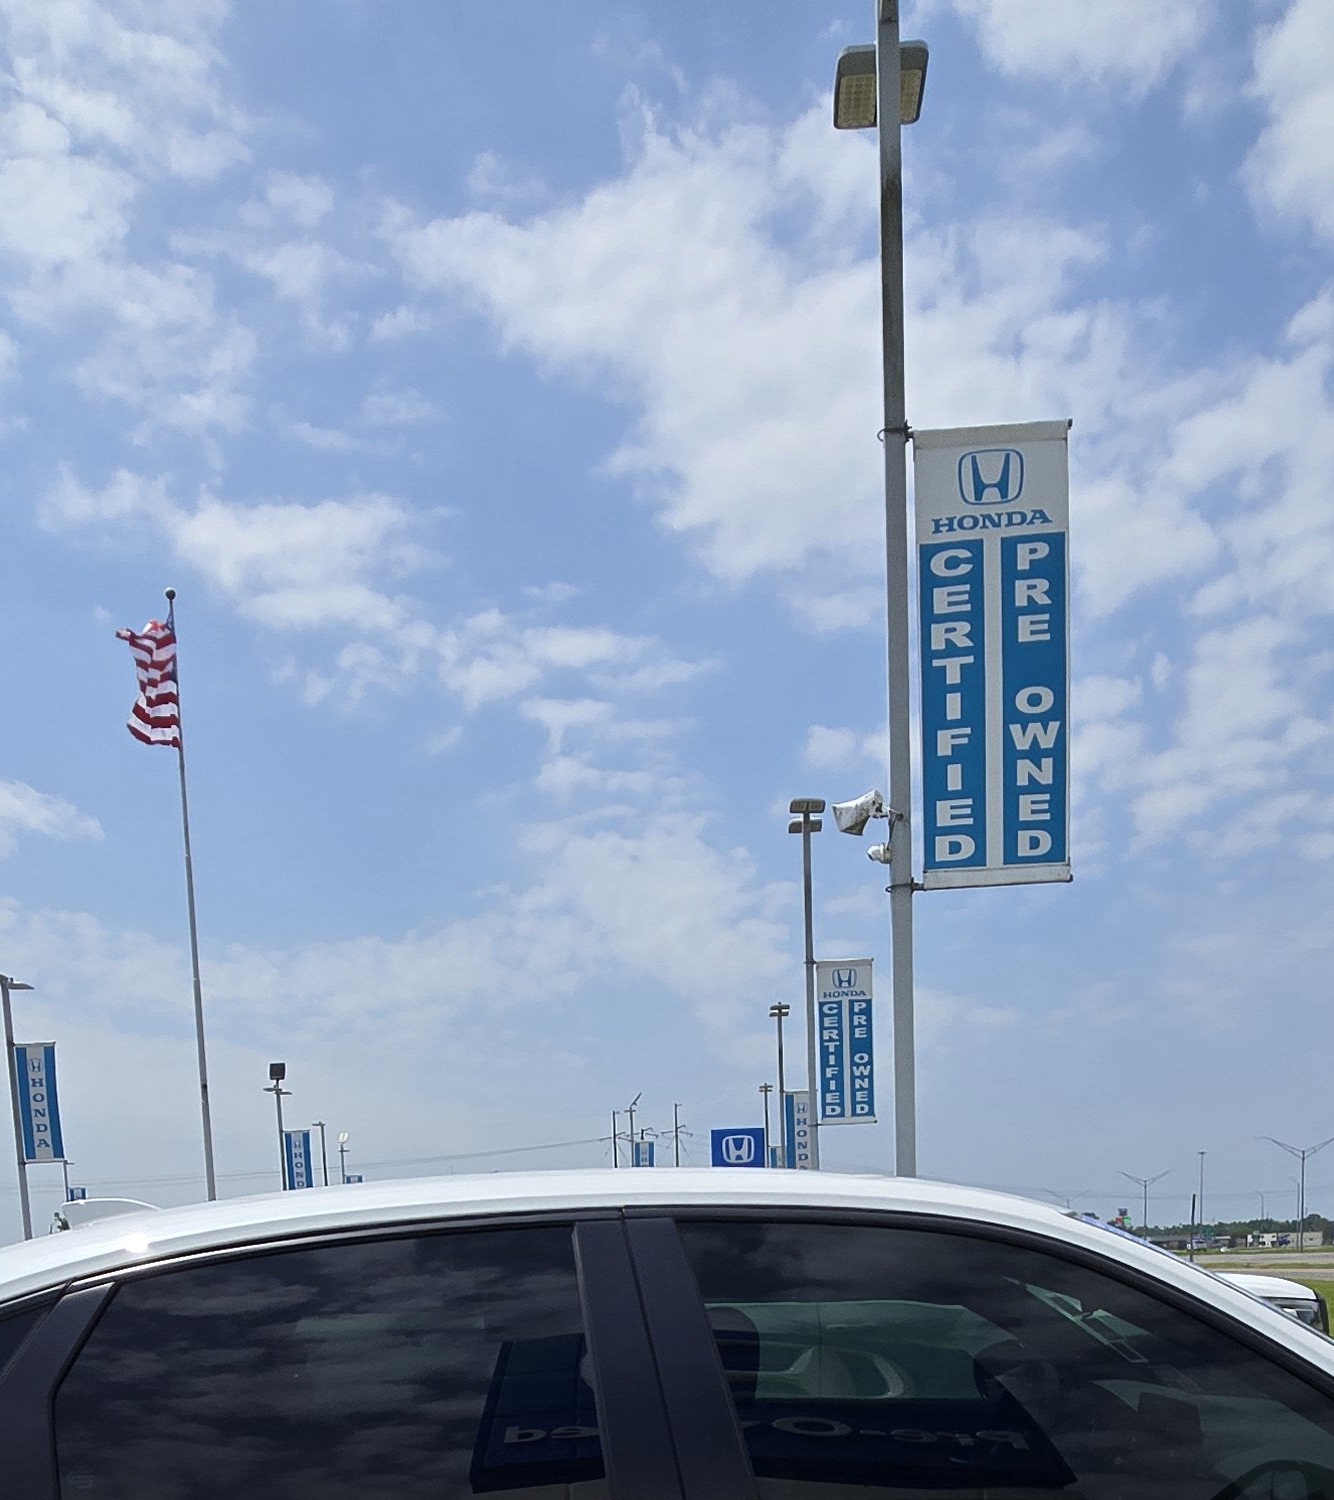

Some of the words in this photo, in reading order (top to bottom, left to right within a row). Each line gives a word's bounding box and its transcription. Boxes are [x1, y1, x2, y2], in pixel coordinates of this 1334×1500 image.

[931, 508, 1053, 535] HONDA
[1014, 541, 1052, 643] PRE
[929, 548, 976, 863] CERTIFIED
[1009, 685, 1061, 858] OWNED
[823, 989, 867, 999] HONDA
[853, 1002, 867, 1039] PRE
[822, 1003, 842, 1116] CERTIFIED
[852, 1053, 871, 1115] OWNED
[30, 1078, 50, 1148] HONDA
[294, 1152, 305, 1187] HOND
